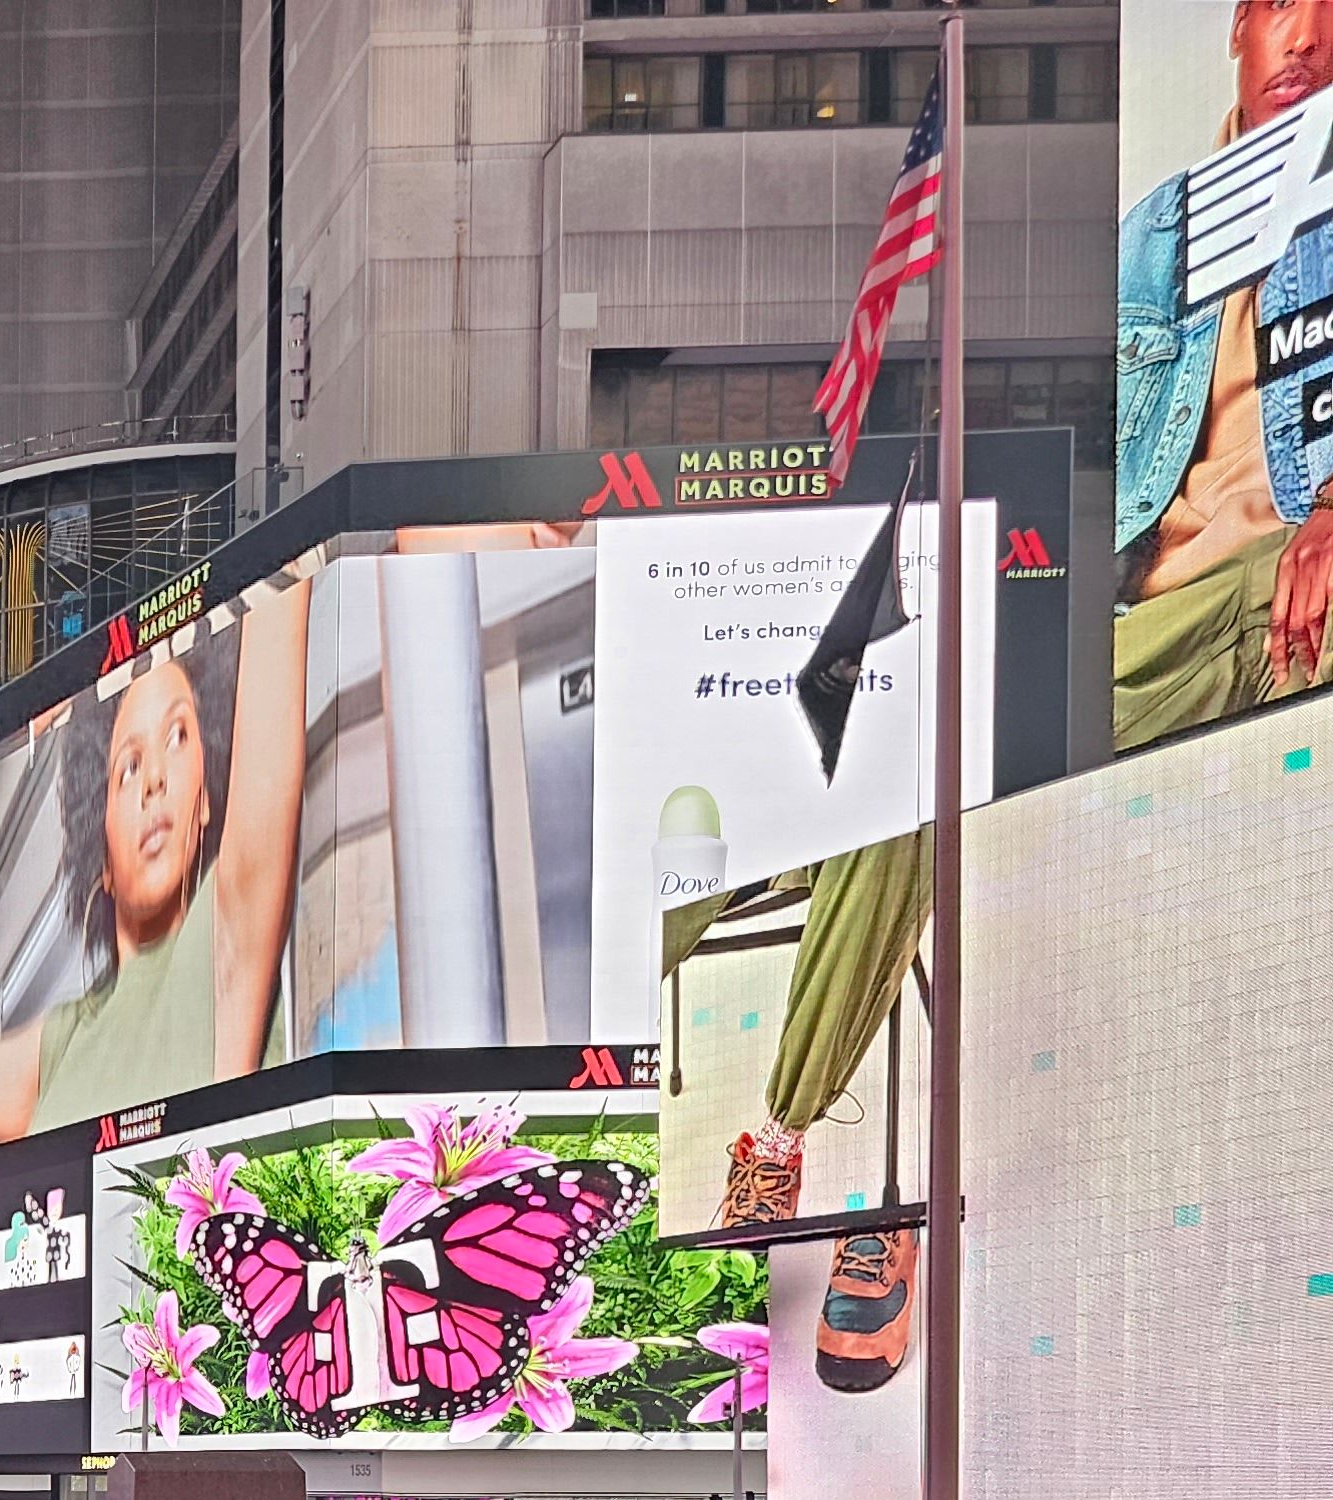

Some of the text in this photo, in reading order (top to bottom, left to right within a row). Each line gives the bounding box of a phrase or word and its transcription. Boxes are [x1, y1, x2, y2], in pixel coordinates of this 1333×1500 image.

[679, 445, 833, 473] MARRIOT
[679, 472, 829, 501] MARQUIS
[647, 553, 858, 579] 6 in 10 of us admit to
[1005, 566, 1067, 580] MARRIOTT
[139, 561, 212, 622] MARRIOTT
[673, 581, 729, 600] other
[733, 577, 826, 598] women's
[138, 592, 203, 646] MARQUIS
[703, 623, 751, 642] Let's
[660, 868, 720, 898] Dove
[118, 1102, 166, 1128] MARRIOTT
[118, 1119, 161, 1143] MARQUIS
[349, 1463, 372, 1478] 1535
